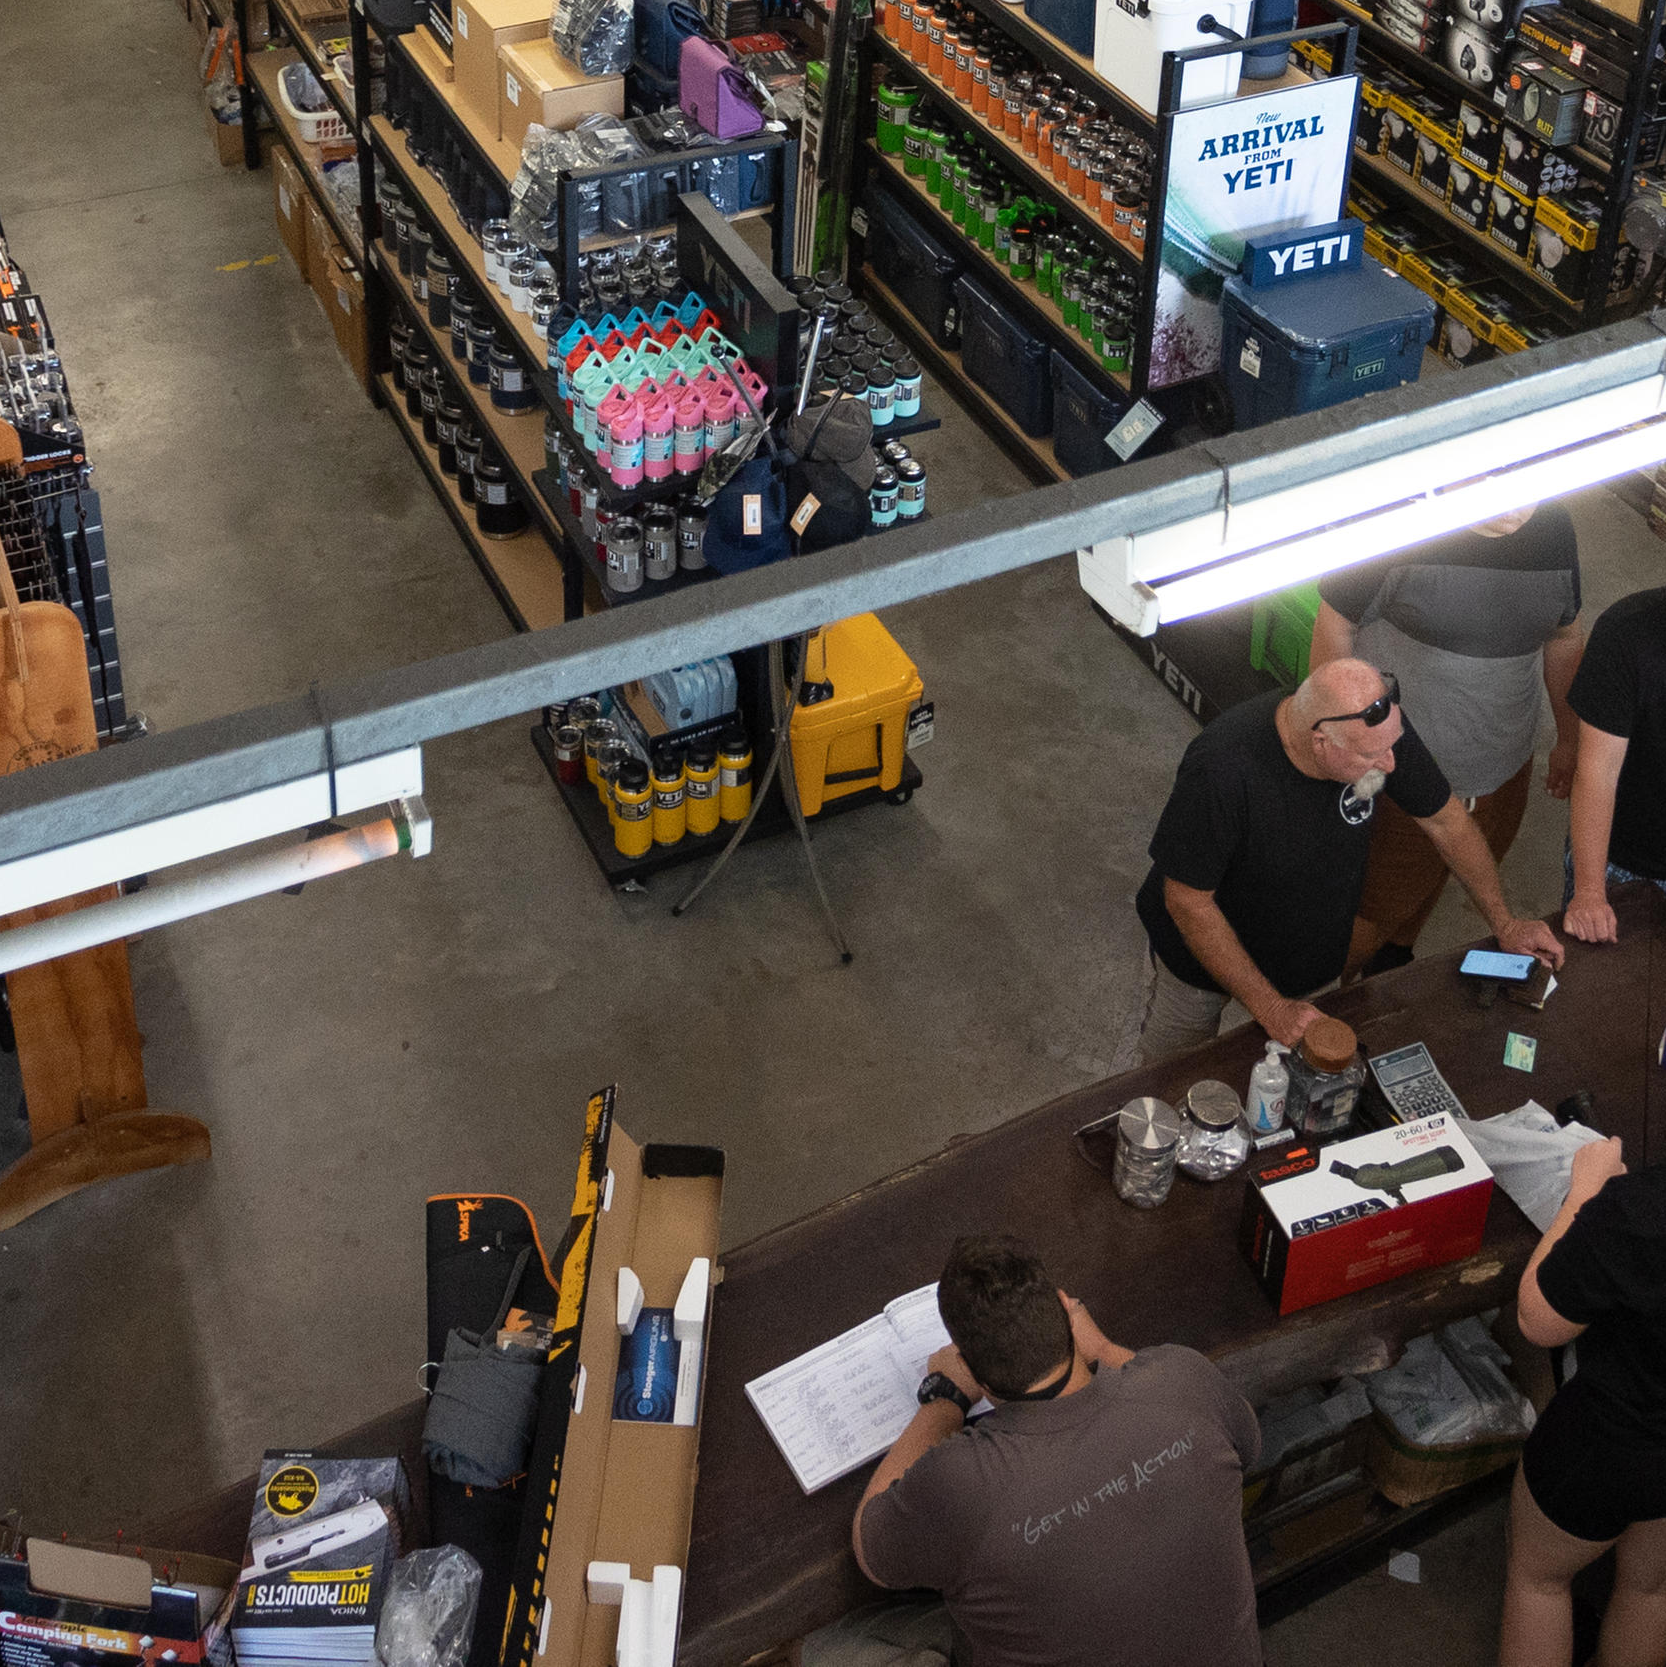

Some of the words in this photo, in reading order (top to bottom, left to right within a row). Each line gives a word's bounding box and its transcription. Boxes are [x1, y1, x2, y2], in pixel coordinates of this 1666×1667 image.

[1256, 112, 1281, 125] New
[1536, 118, 1554, 137] BLITZ
[1198, 114, 1325, 162] ARRIVAL
[1244, 148, 1282, 166] FROM
[1387, 149, 1411, 173] STRIKER
[1461, 145, 1489, 170] STRIKER
[1223, 159, 1294, 195] YETI
[1502, 169, 1529, 194] STRIKER
[1451, 203, 1477, 226] STRIKER
[1492, 226, 1518, 252] STRIKER
[1269, 234, 1351, 276] YETI
[1536, 263, 1554, 282] BLITZ
[1356, 363, 1382, 378] YETI
[1150, 640, 1201, 714] YETI
[1403, 1133, 1428, 1147] SPOTTING
[1428, 1128, 1447, 1140] SCOPE
[1259, 1157, 1316, 1181] tasco
[457, 1211, 471, 1242] SPIKA
[648, 1315, 661, 1360] AIRGUNS
[641, 1360, 655, 1399] Stoeger
[1070, 1495, 1092, 1515] IN
[1092, 1476, 1131, 1505] THE
[86, 1636, 128, 1652] Fork
